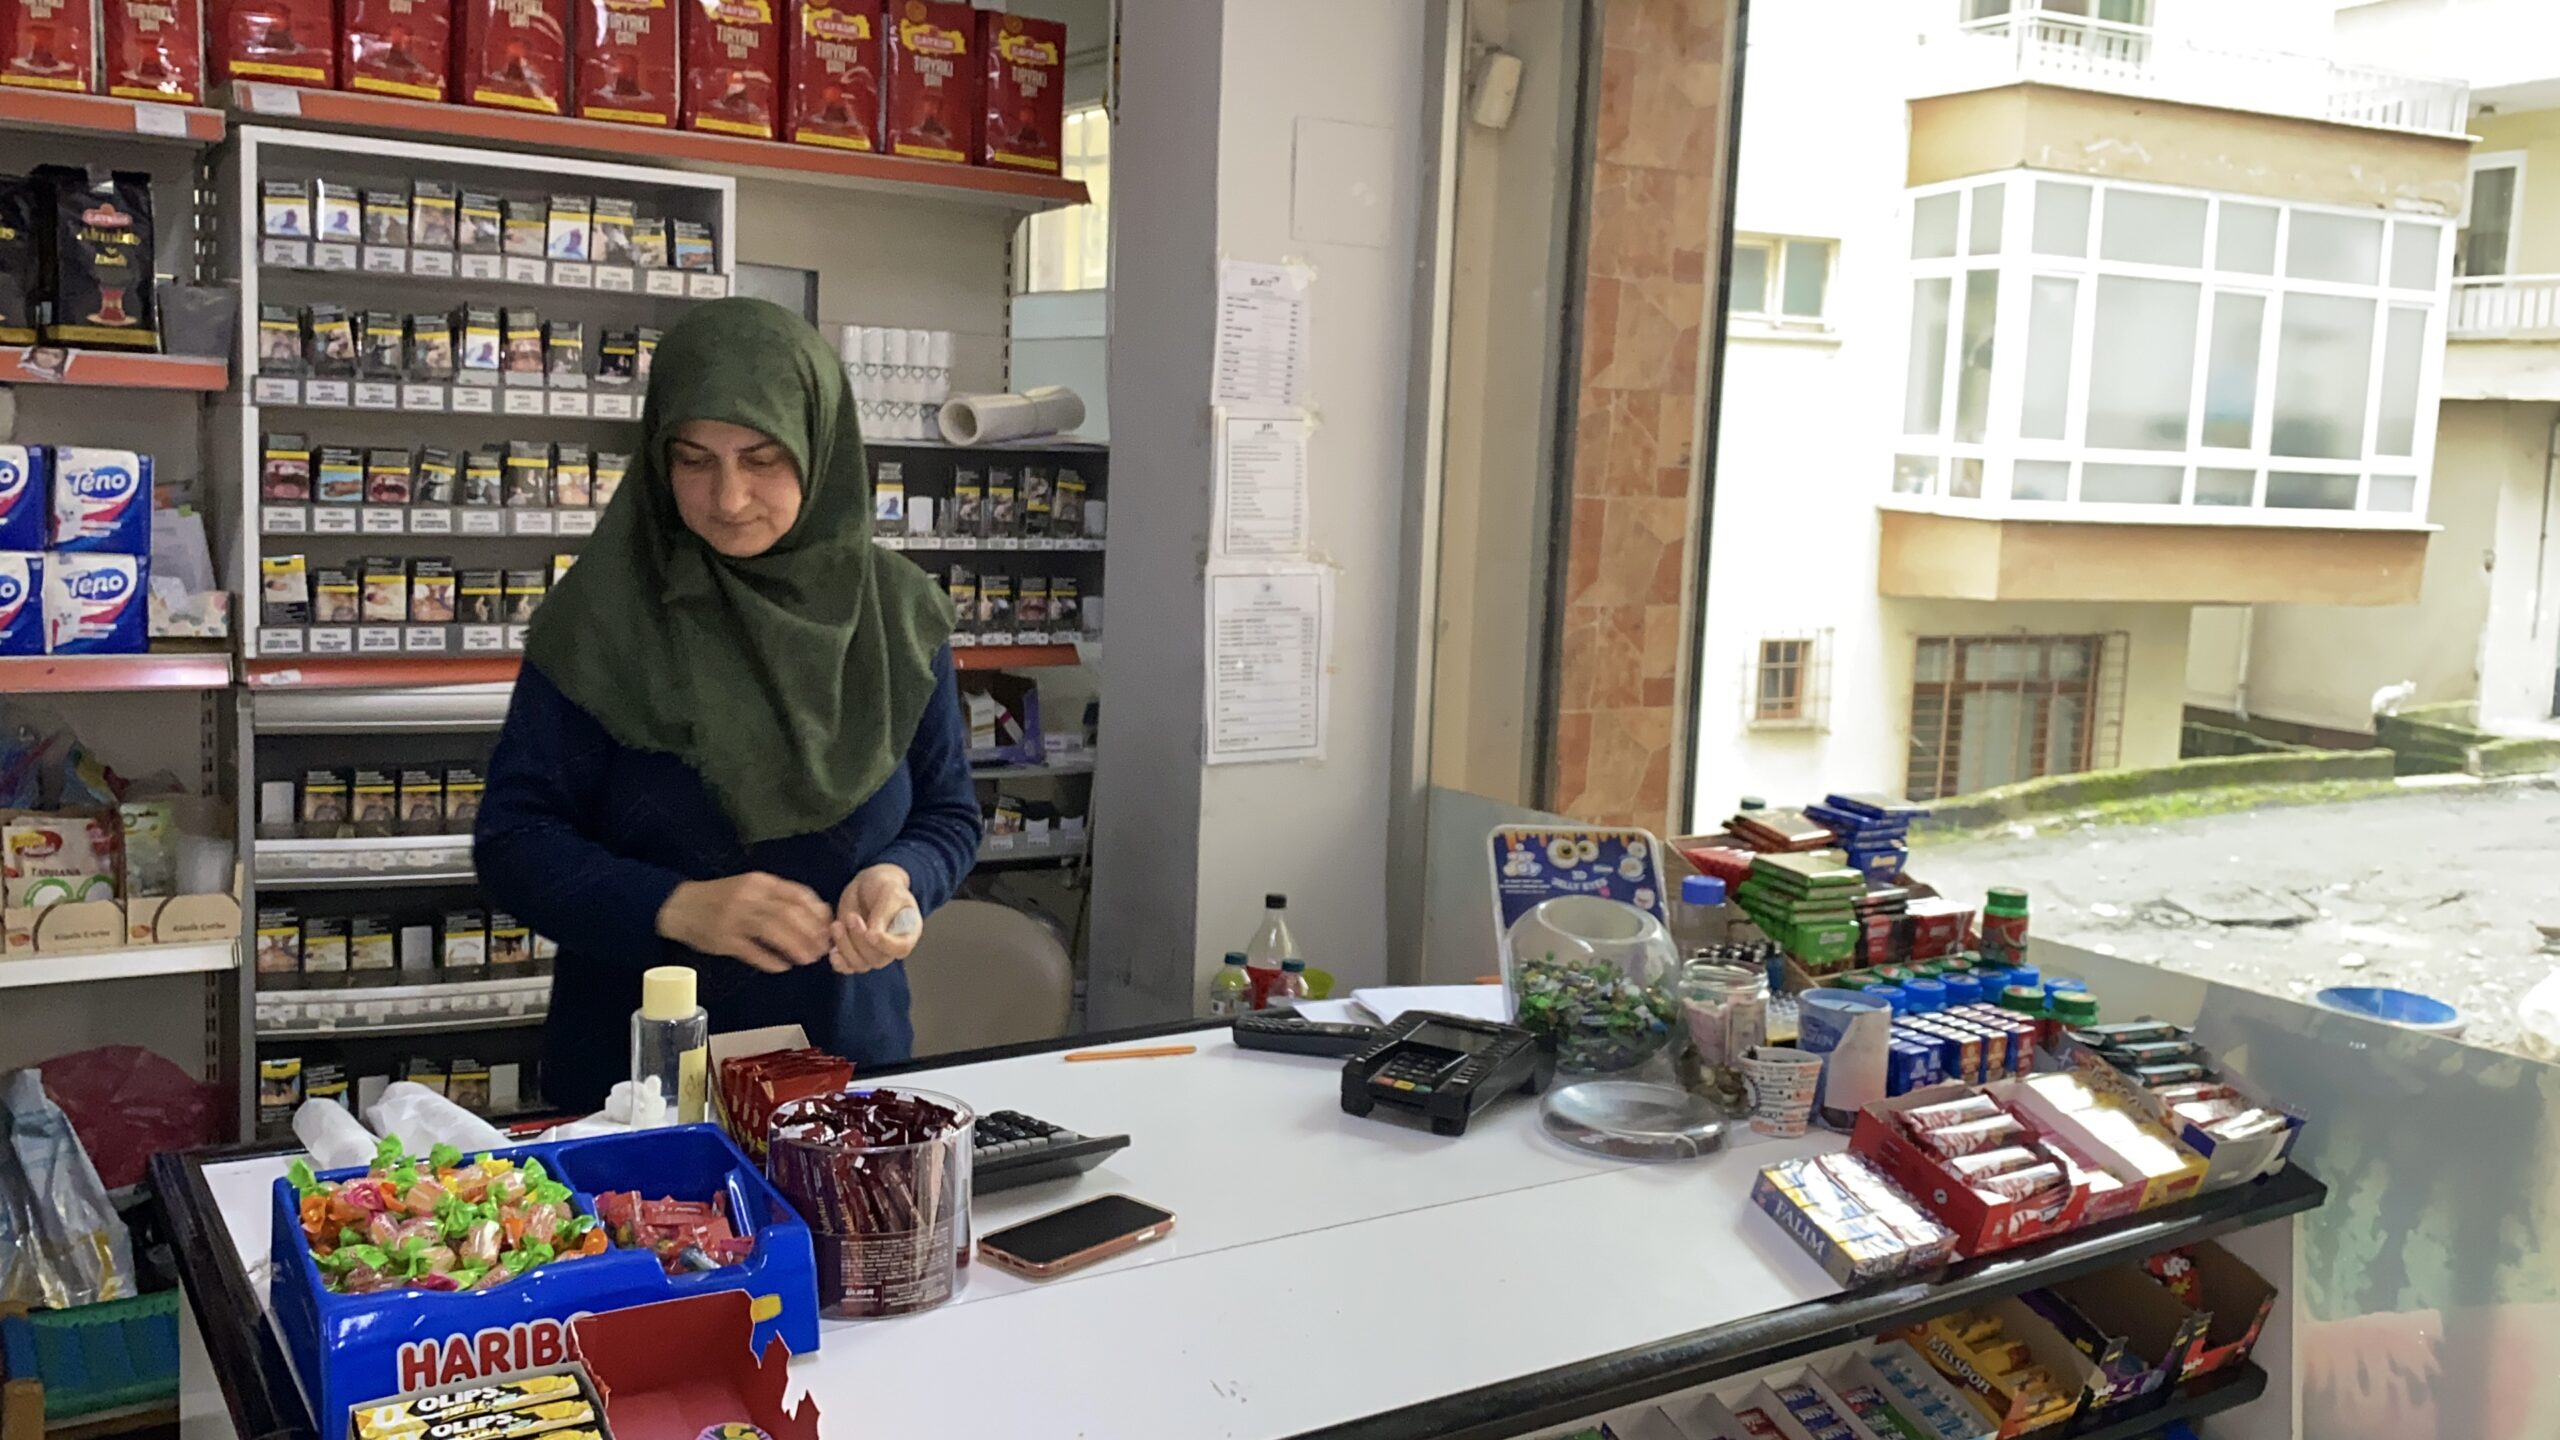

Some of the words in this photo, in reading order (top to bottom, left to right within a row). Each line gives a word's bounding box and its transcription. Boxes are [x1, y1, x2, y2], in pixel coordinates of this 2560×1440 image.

[1773, 1199, 1826, 1256] FALIM
[1925, 1334, 1993, 1395] Missbon
[416, 1386, 500, 1412] OLIPS
[430, 1411, 514, 1438] OLIPS
